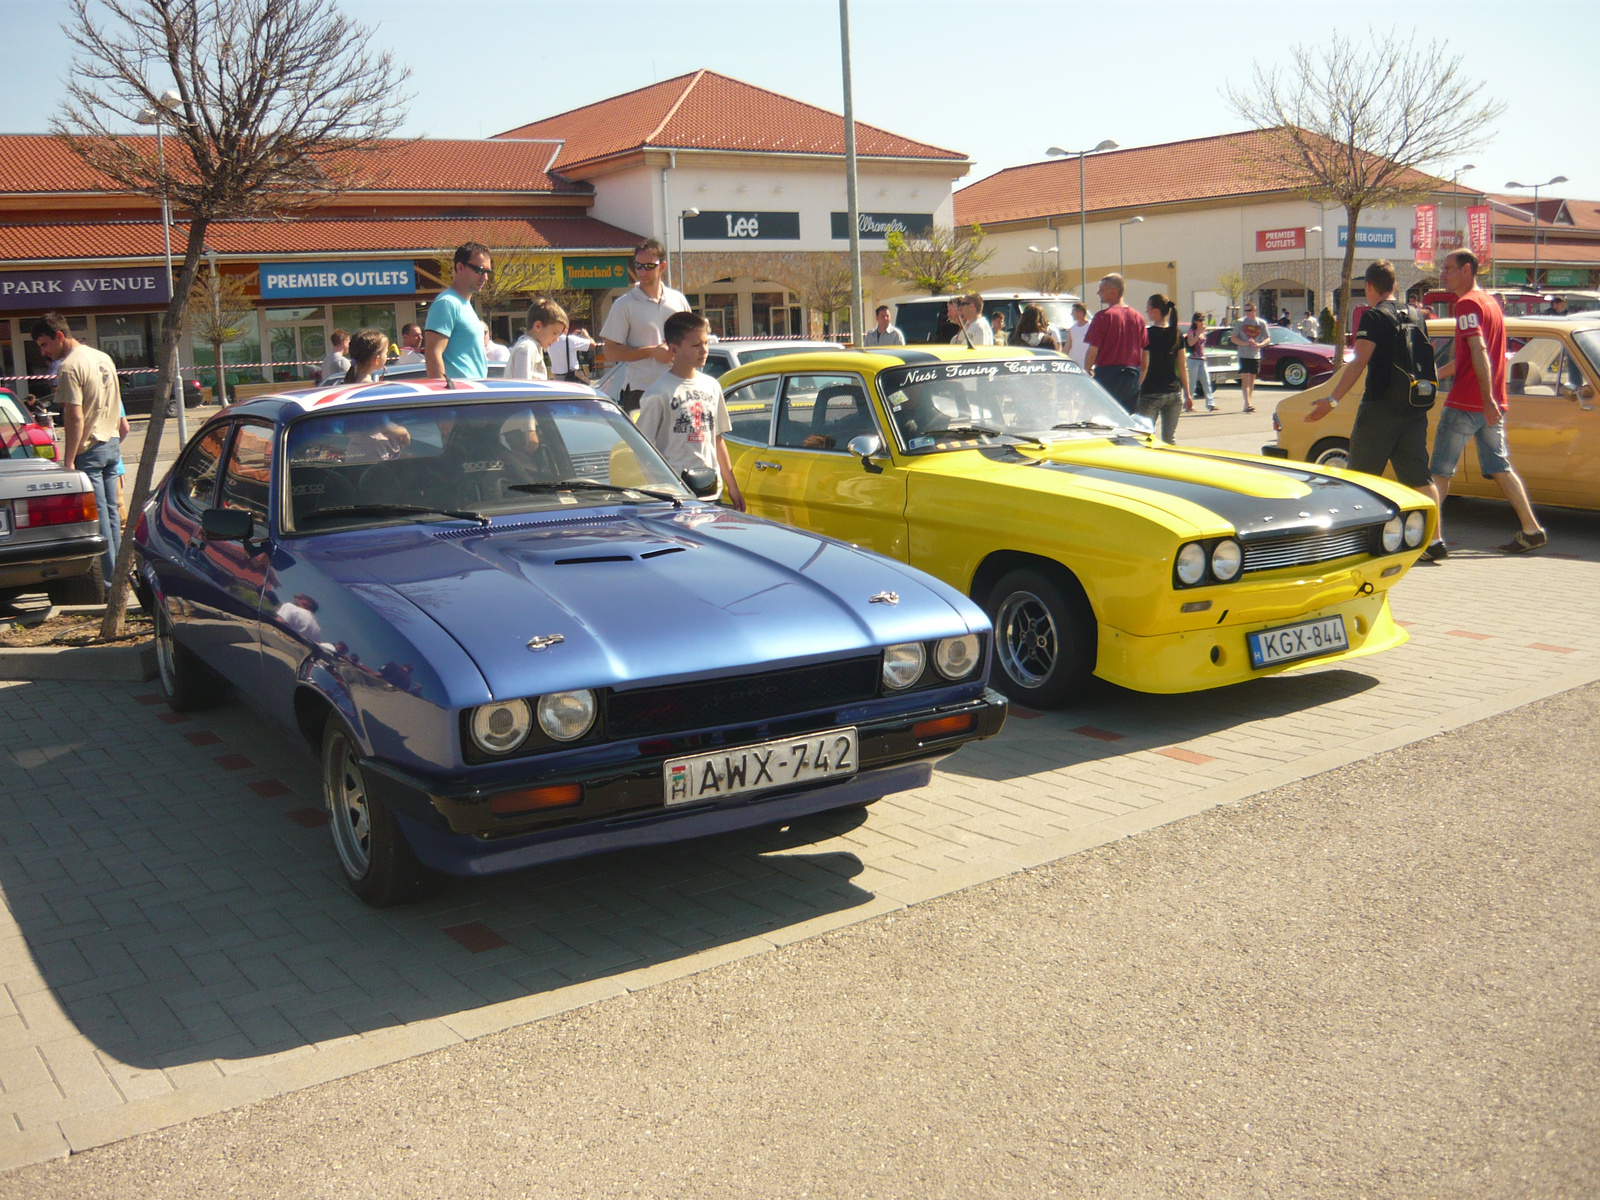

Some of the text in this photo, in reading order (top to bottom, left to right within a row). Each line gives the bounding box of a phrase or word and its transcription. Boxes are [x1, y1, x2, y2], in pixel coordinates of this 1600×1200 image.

[726, 214, 759, 238] Lee
[858, 214, 907, 238] Wrangler
[1265, 239, 1296, 249] OUTLETS
[1340, 232, 1394, 244] PRIER OUTLETS
[341, 271, 409, 287] OUTLETS
[566, 264, 612, 279] Timberland
[3, 276, 156, 295] PARK AVENUE
[1459, 312, 1479, 331] 09
[900, 369, 937, 387] Nusi
[945, 364, 1000, 382] Tuning
[1003, 361, 1047, 376] Capri
[1253, 621, 1342, 660] H KGX-844
[671, 735, 851, 800] H AWX-742
